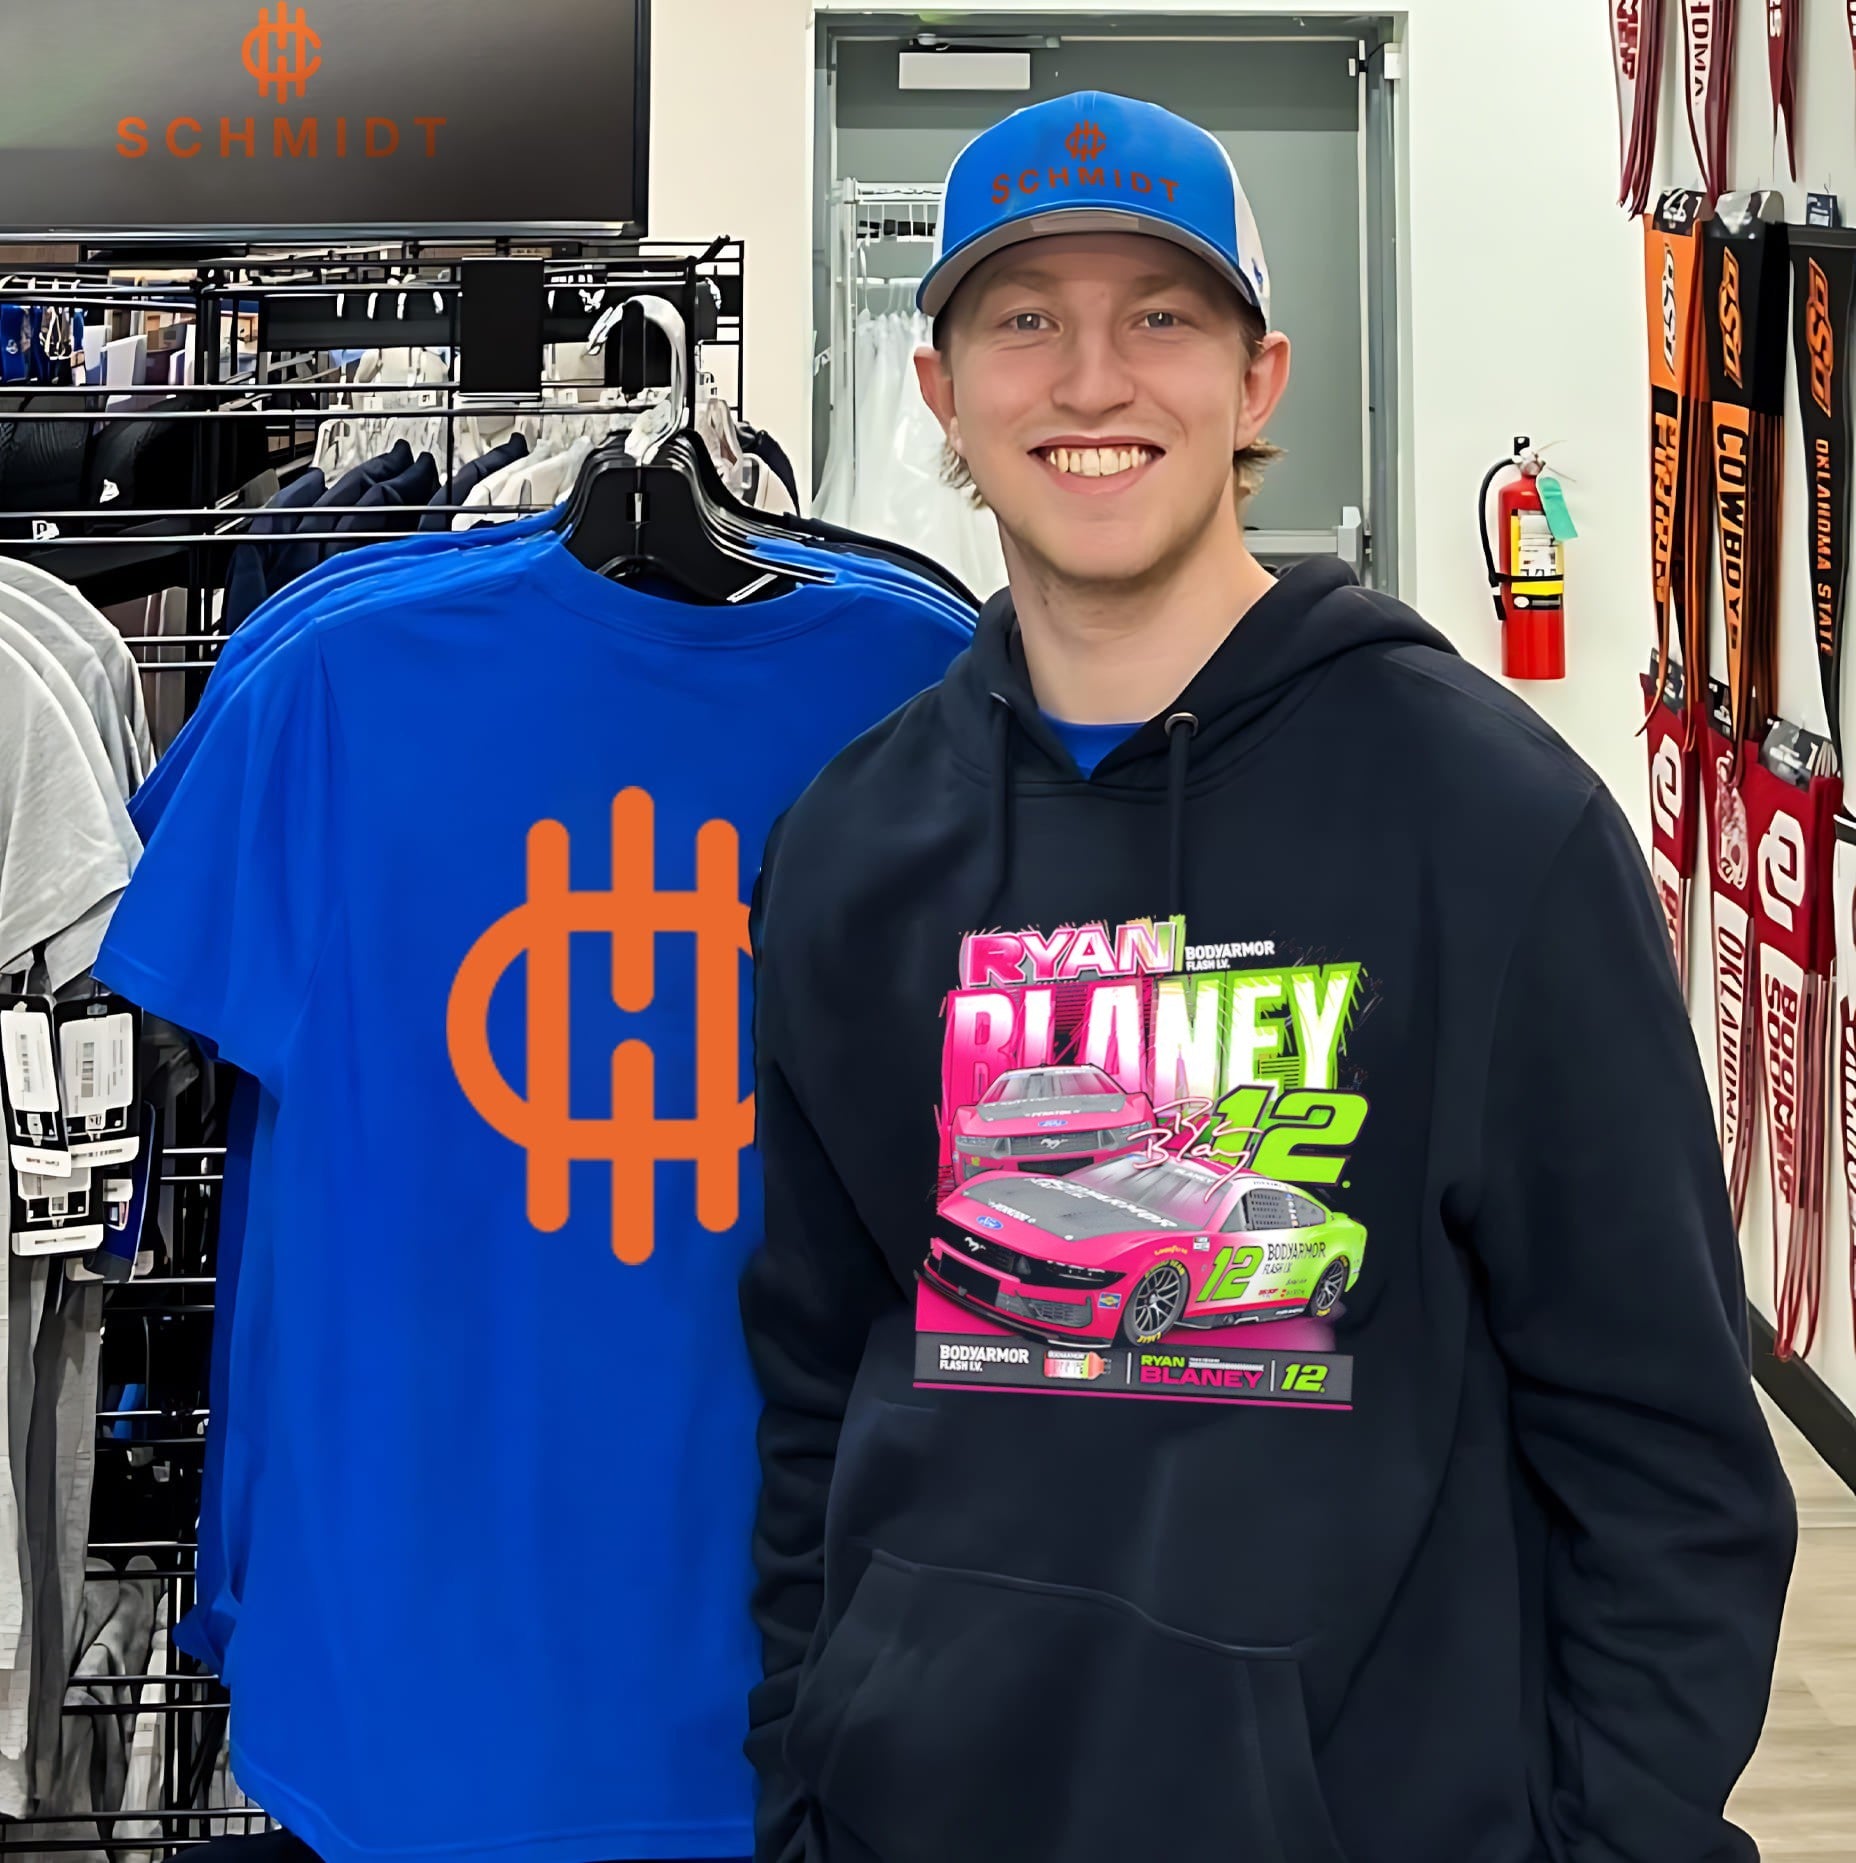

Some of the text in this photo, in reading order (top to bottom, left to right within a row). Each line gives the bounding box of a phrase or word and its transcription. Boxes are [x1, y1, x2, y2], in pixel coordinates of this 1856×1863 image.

[116, 116, 448, 159] SCHMIDT
[991, 166, 1180, 205] SCHMIDT
[1815, 438, 1832, 570] OKLAHOMA
[967, 921, 1176, 986] RYAN
[1184, 940, 1275, 960] BODYARMOR
[1185, 959, 1215, 972] FLASH
[948, 963, 1361, 1102] BLANEY
[1267, 1242, 1327, 1261] BODYARMOR
[1195, 1245, 1265, 1303] 12
[939, 1344, 1030, 1364] BODYARMOR
[939, 1360, 968, 1371] FLASH
[1140, 1354, 1185, 1368] RYAN
[1140, 1365, 1264, 1389] BLANEY
